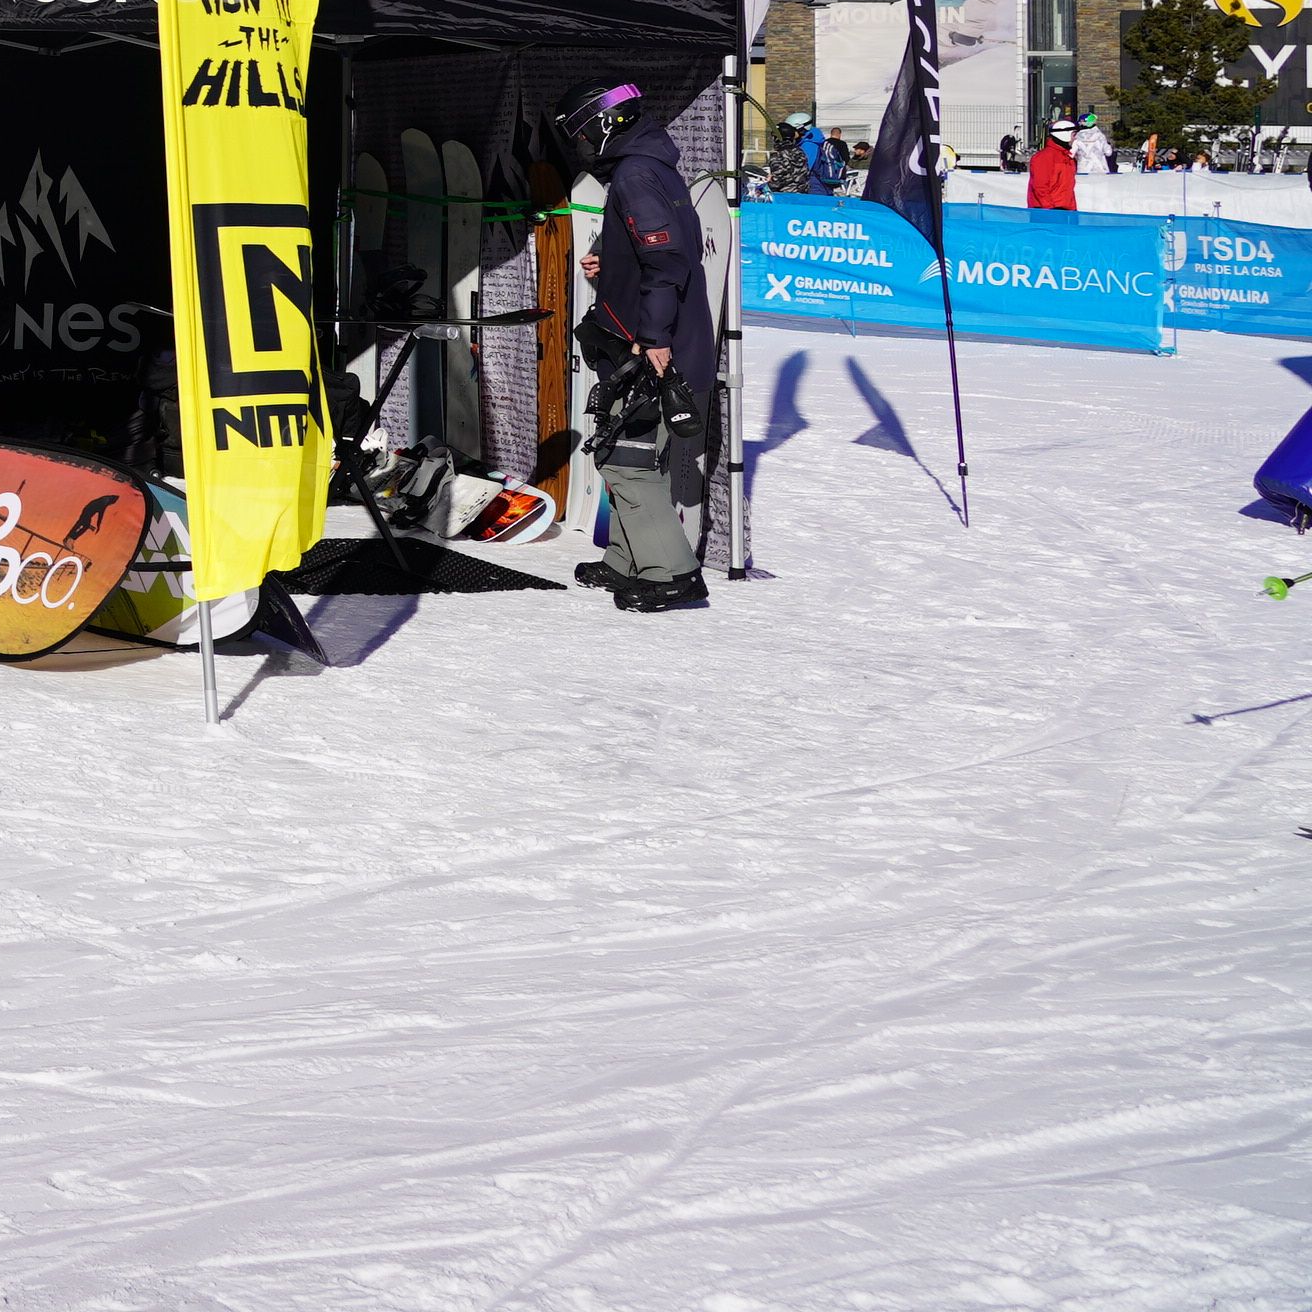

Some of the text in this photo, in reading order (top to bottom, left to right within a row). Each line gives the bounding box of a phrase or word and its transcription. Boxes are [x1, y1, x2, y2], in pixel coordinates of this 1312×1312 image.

[829, 6, 967, 24] MOUNIN
[239, 25, 280, 52] THE
[787, 219, 870, 241] CARRIL
[761, 241, 893, 268] INDIVIDUAL
[1197, 235, 1275, 264] TSD4
[1195, 264, 1283, 278] PAS DE LA CASA
[794, 276, 894, 297] GRANDVALIRA
[1179, 285, 1269, 305] GRANDVALIRA
